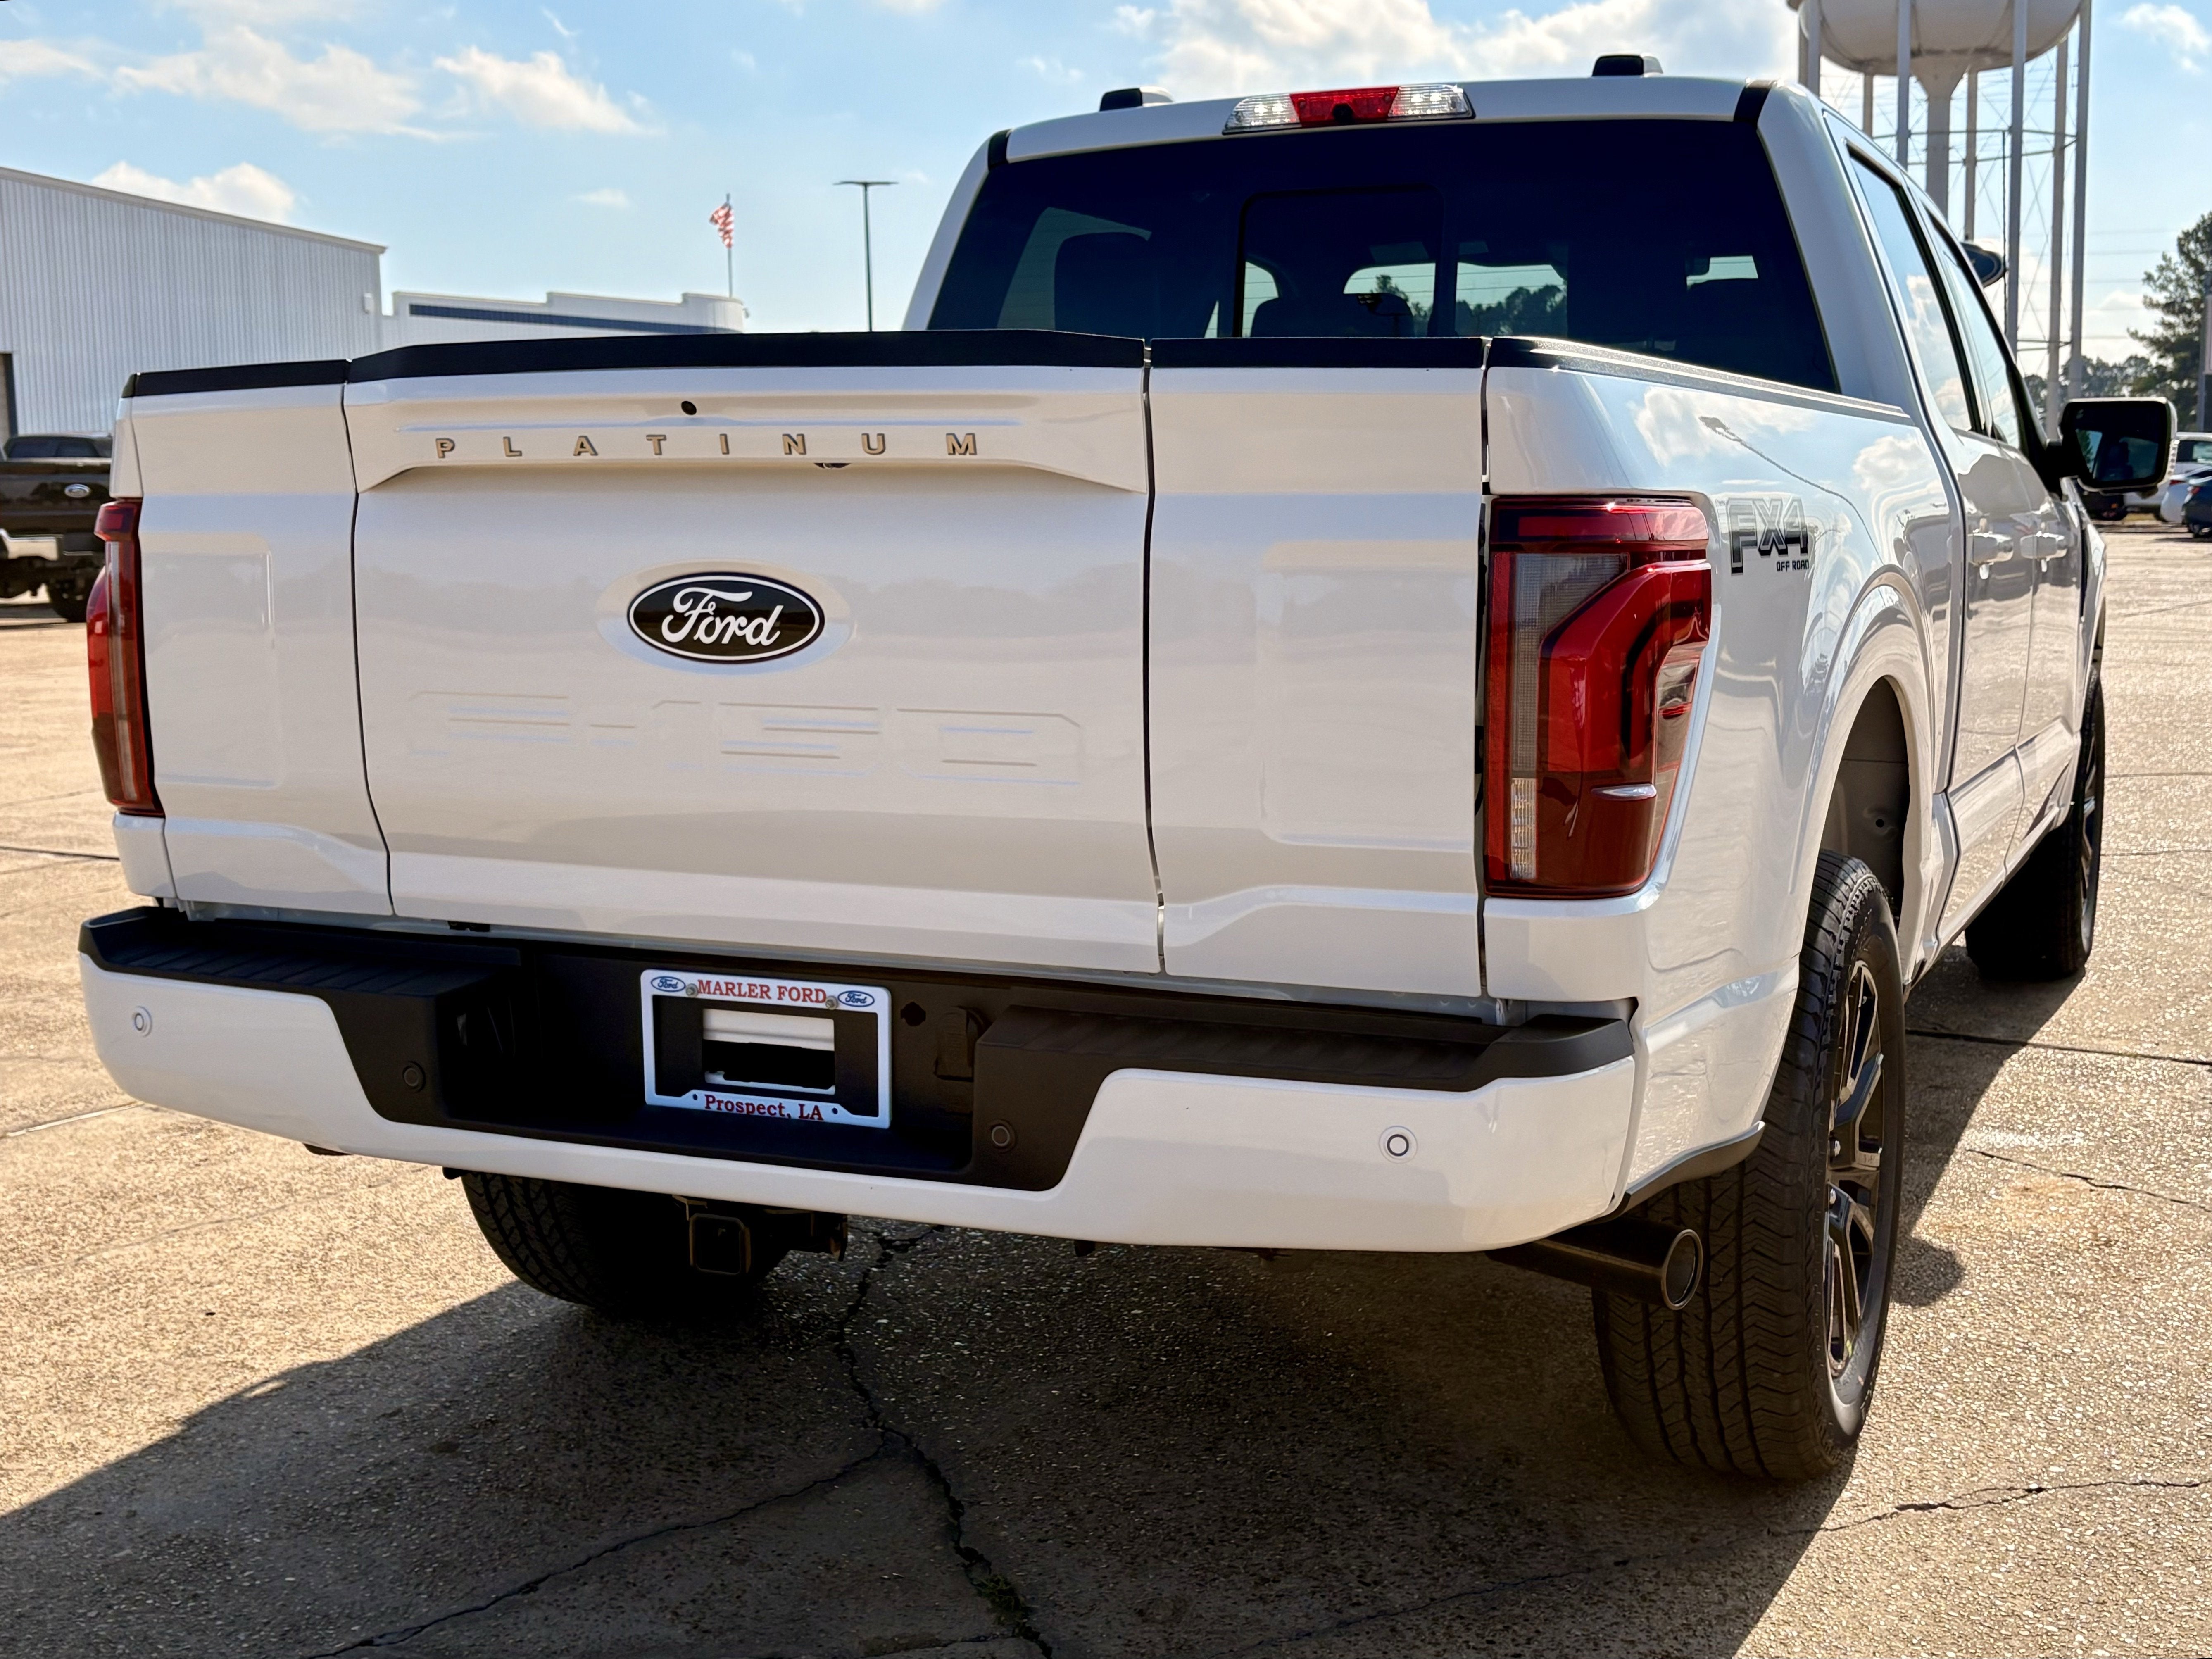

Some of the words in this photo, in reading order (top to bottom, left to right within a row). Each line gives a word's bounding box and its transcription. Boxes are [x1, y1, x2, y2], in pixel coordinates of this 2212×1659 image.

[435, 432, 978, 458] PLATINUM
[1727, 497, 1808, 574] FX4
[1777, 561, 1789, 571] OFF
[1792, 560, 1809, 570] ROAD
[662, 587, 783, 646] Ford
[657, 977, 678, 990] Ford
[697, 980, 771, 1000] MARLER
[778, 985, 826, 1003] FORD
[844, 992, 867, 1004] Ford
[704, 1095, 790, 1119] Prospect,
[799, 1104, 823, 1121] LA
